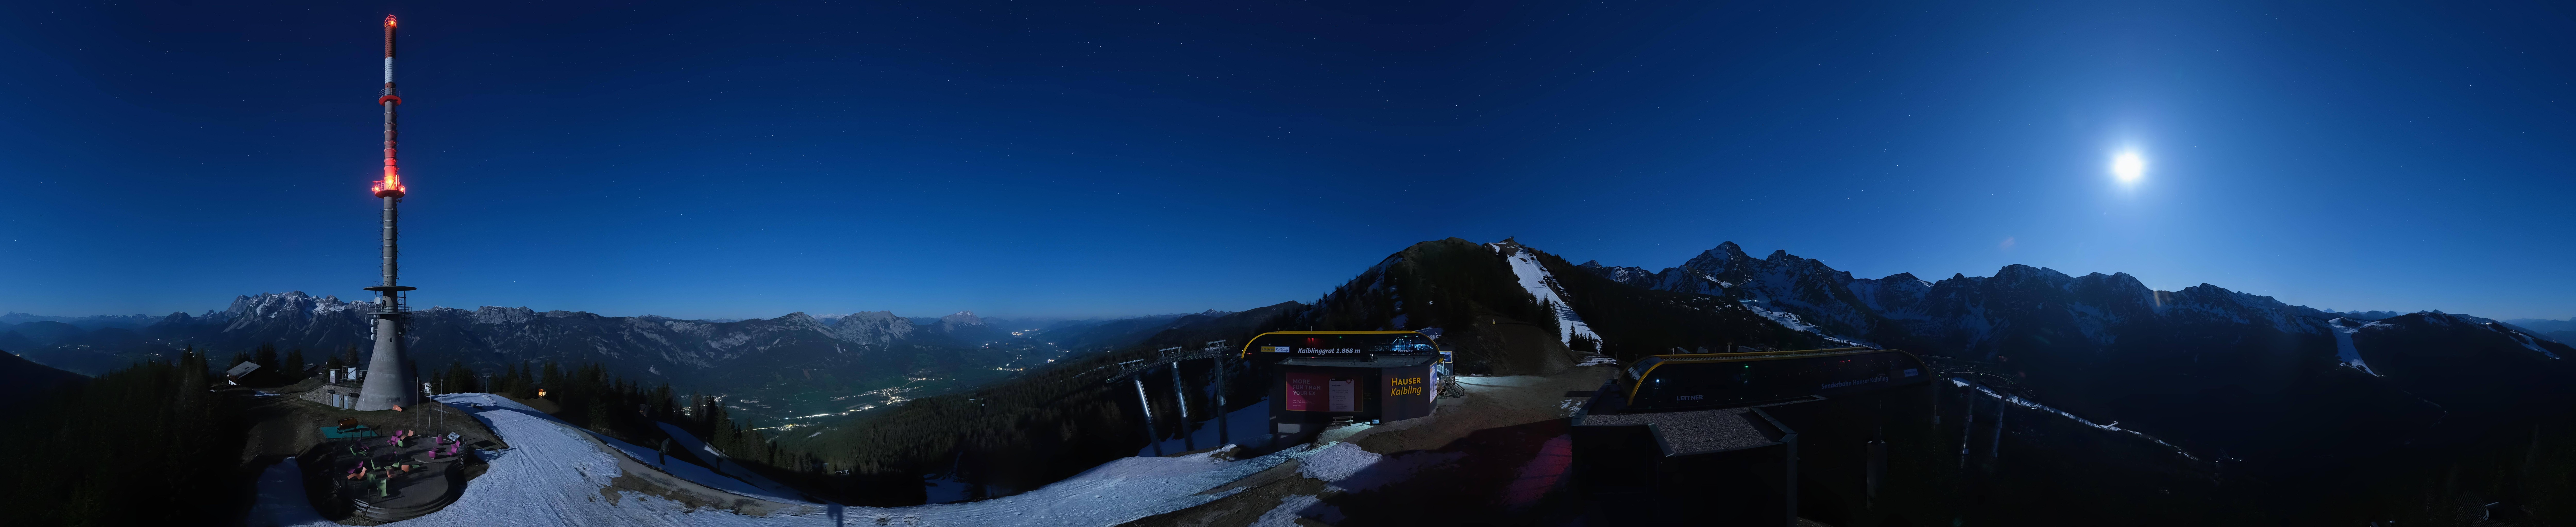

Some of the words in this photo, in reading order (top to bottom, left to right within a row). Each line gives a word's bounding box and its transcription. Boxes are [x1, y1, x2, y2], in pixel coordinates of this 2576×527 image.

[1391, 377, 1421, 386] HAUSER
[1821, 380, 1852, 389] Senderbahn
[1391, 386, 1421, 396] Kaibling
